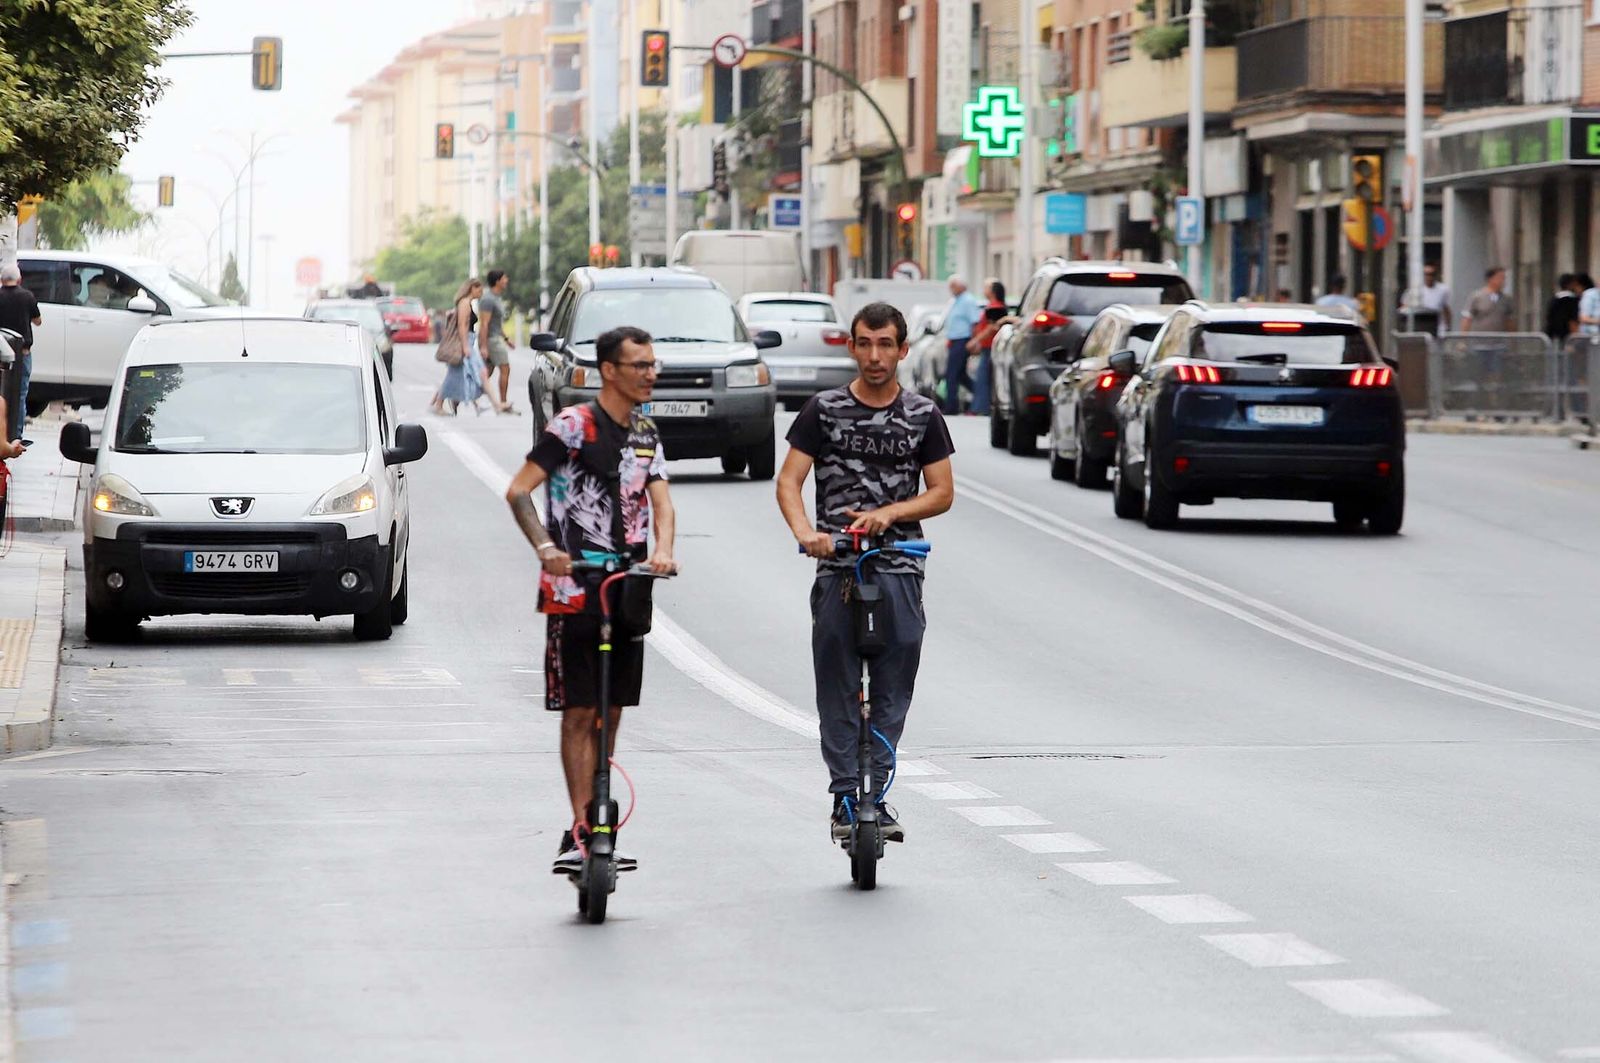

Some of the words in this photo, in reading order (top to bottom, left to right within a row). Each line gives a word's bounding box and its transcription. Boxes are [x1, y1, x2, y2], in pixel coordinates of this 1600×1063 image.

[1180, 202, 1197, 238] P
[664, 403, 691, 415] 7847
[841, 434, 907, 457] JEANS
[195, 554, 236, 569] 9474
[243, 554, 274, 569] GRV
